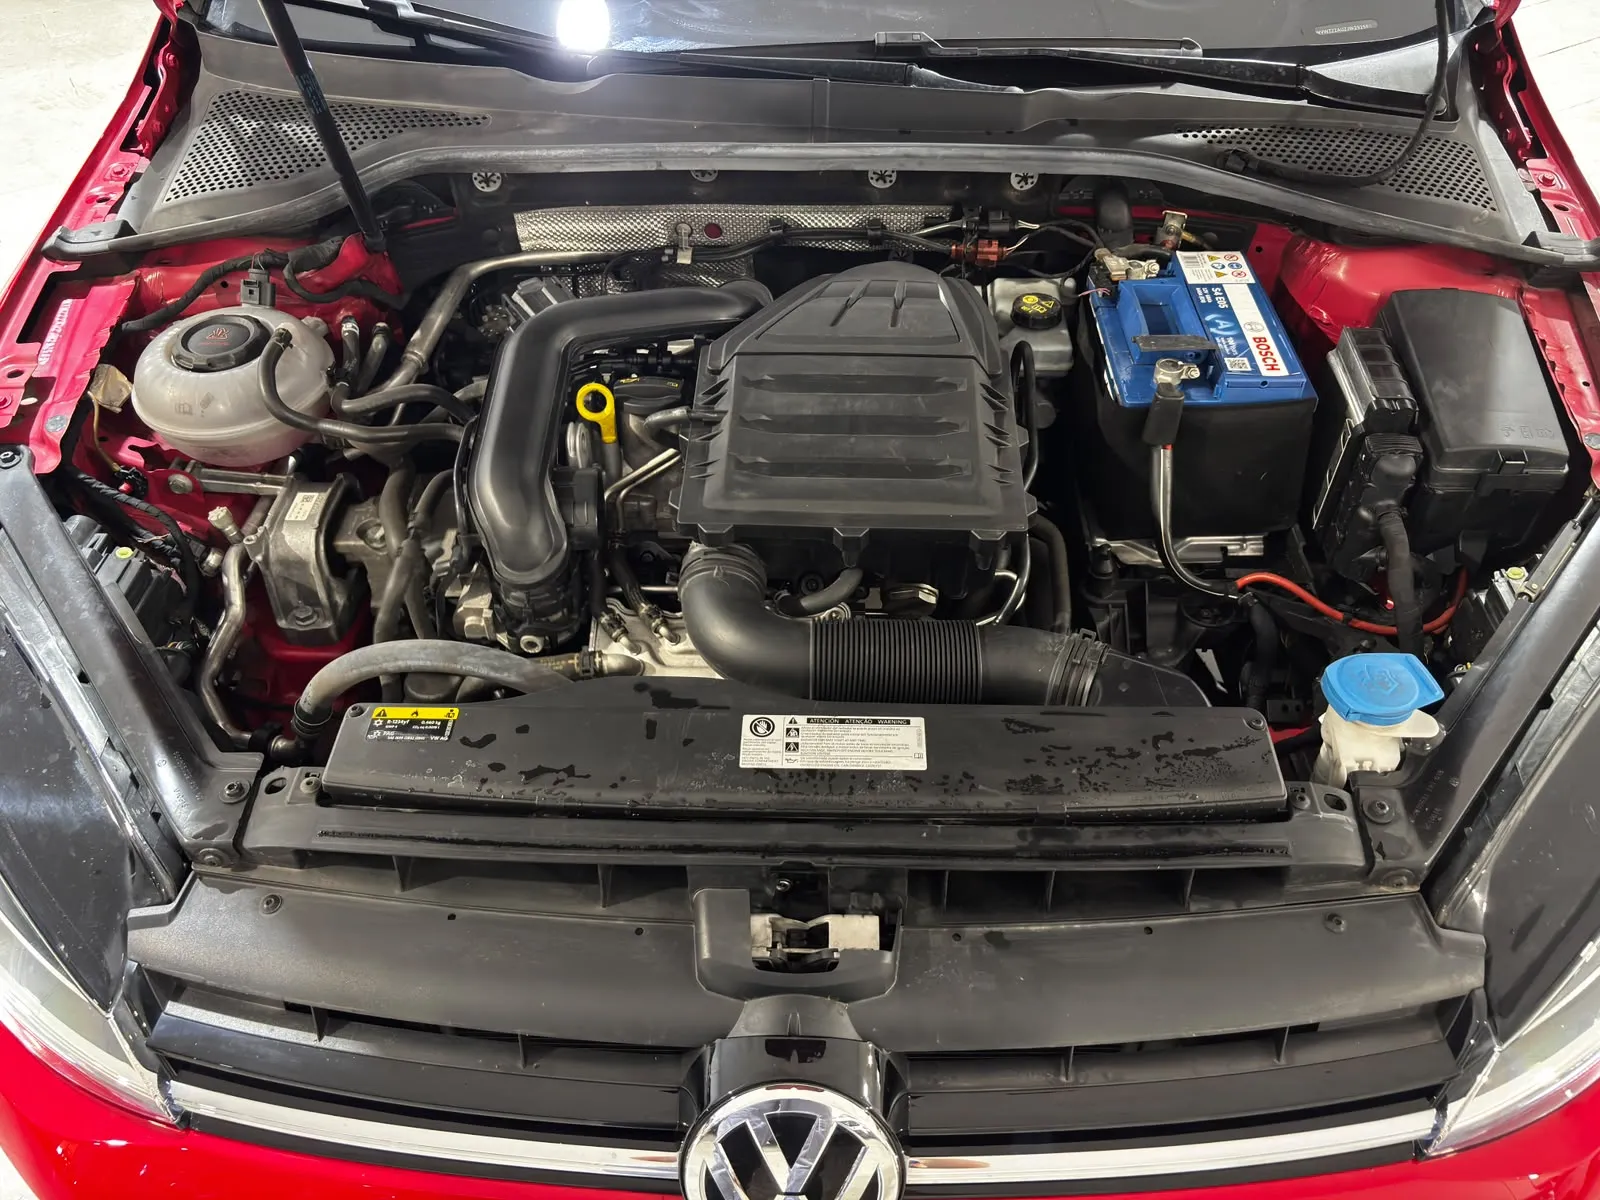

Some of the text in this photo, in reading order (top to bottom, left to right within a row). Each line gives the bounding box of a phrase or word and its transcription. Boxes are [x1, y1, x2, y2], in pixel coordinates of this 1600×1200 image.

[1212, 287, 1228, 309] S4 E05
[1252, 336, 1281, 371] BOSCH
